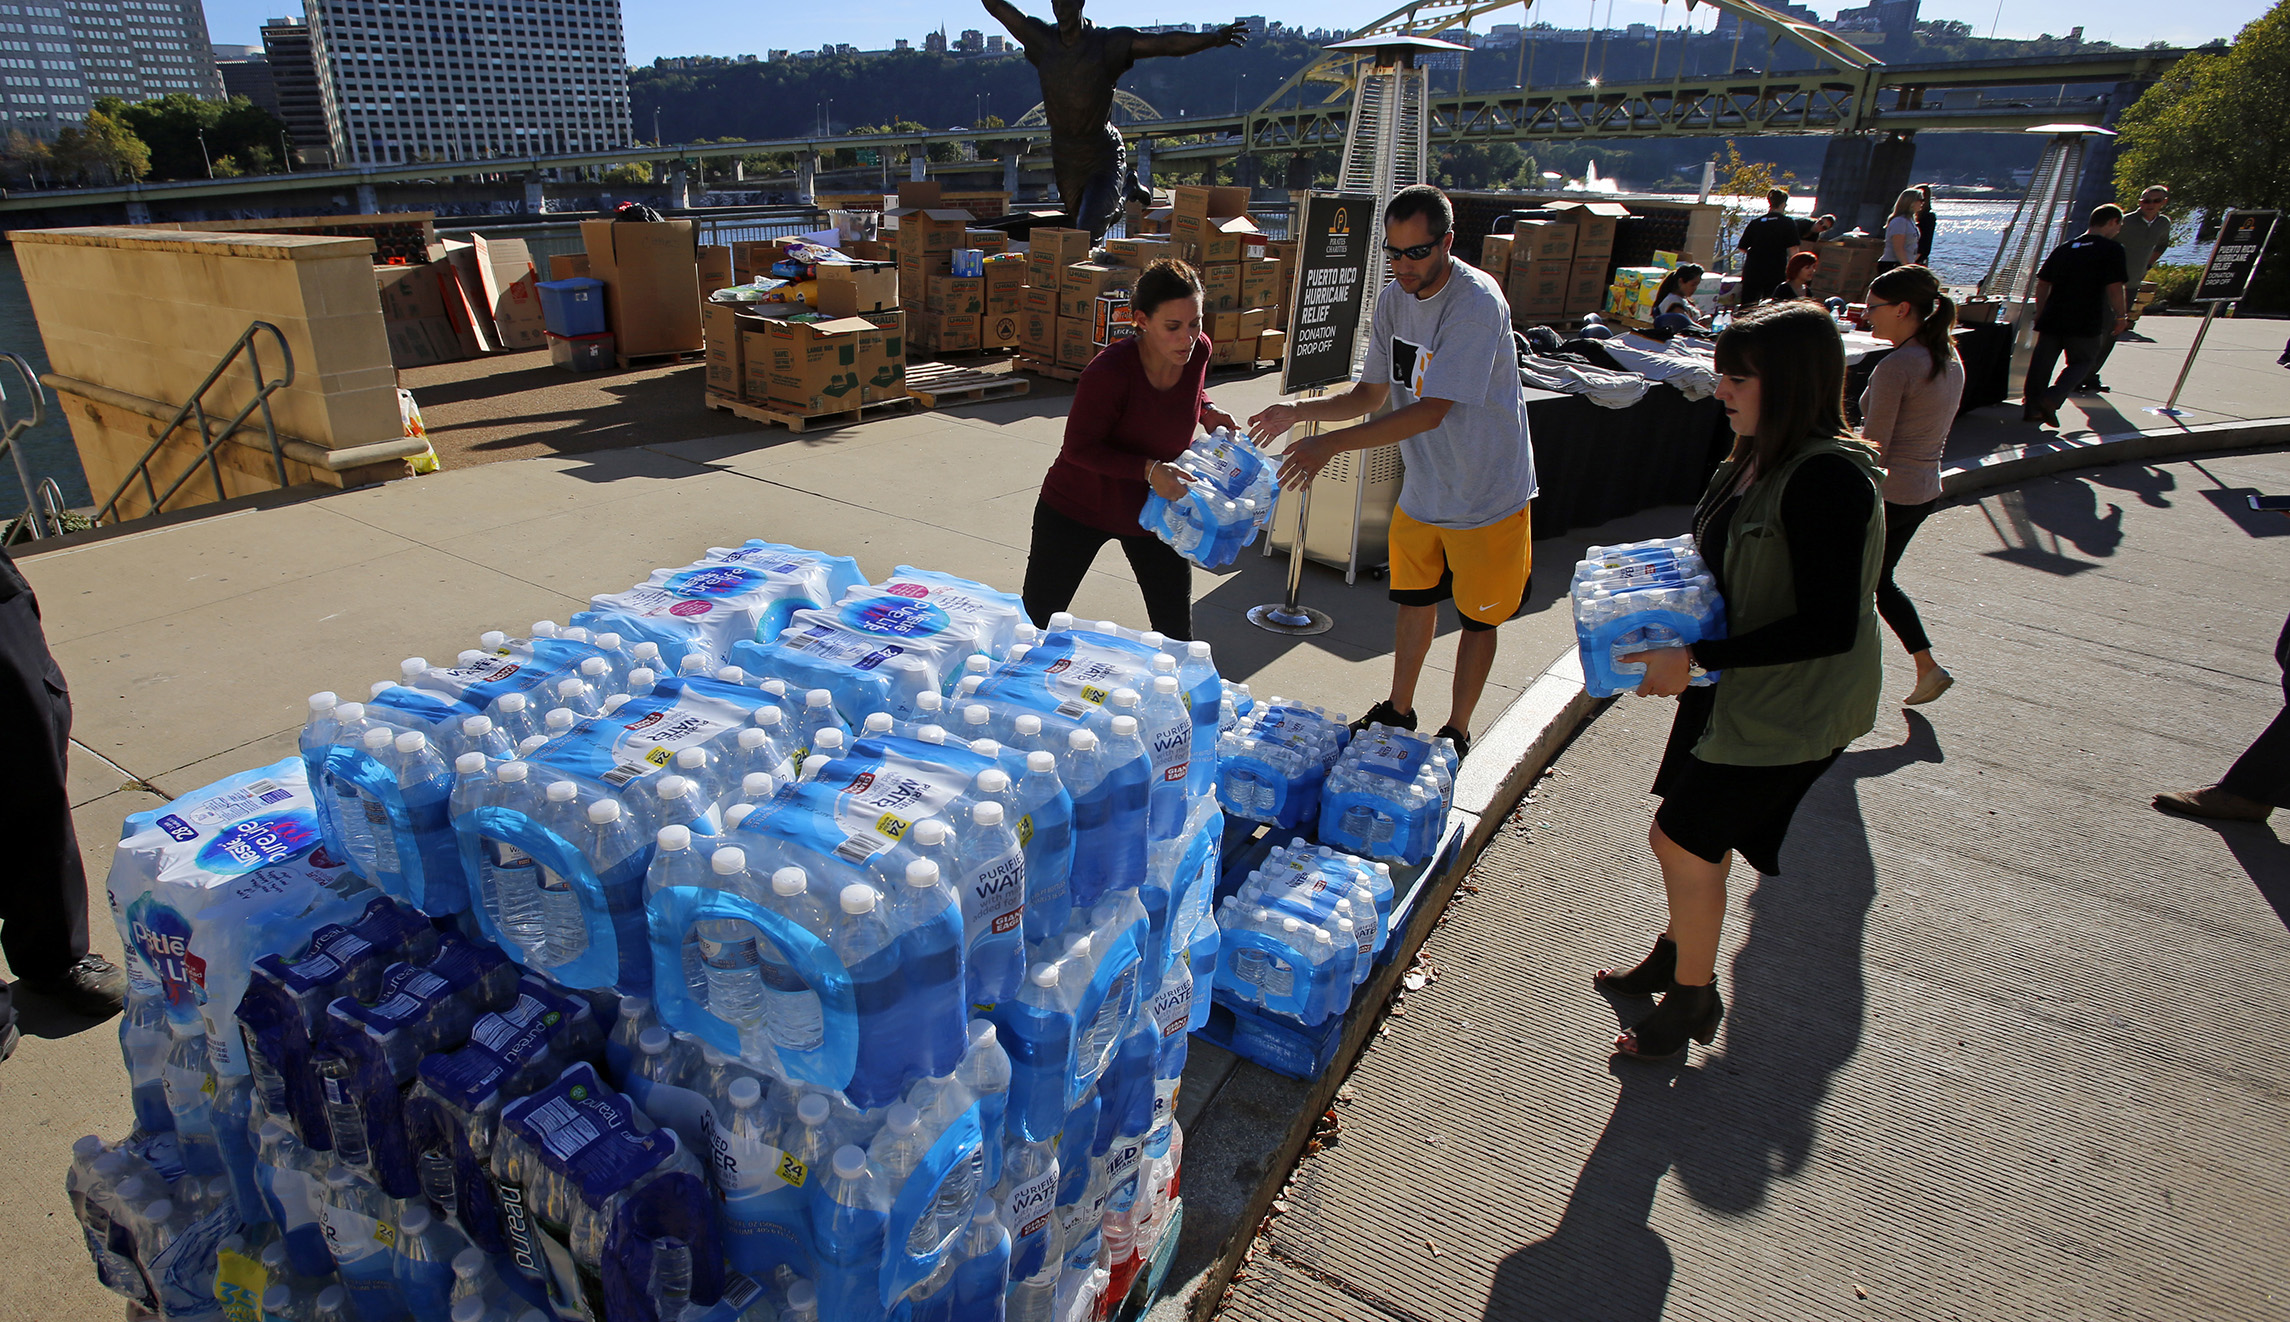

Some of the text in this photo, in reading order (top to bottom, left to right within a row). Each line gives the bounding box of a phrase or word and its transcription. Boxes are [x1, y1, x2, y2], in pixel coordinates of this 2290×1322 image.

[1178, 216, 1199, 226] U-HAUL
[975, 235, 1001, 243] U-HAUL
[1329, 237, 1346, 245] PIRATES
[2215, 253, 2249, 262] HURRICANE
[2218, 245, 2256, 253] PUERTO RICO
[1069, 269, 1090, 279] U-HAUL
[2211, 262, 2232, 271] RELIEF
[1307, 267, 1357, 286] PUERTO RICO
[1304, 286, 1350, 305] HURRICANE
[1301, 305, 1330, 324] RELIEF
[1299, 326, 1336, 342] DONATION
[807, 346, 823, 354] LARGE
[1296, 340, 1333, 357] DROP OFF
[1090, 690, 1105, 703] 24
[1156, 717, 1192, 740] PURIFIE
[1154, 725, 1192, 753] WAT
[653, 751, 671, 765] 24
[1167, 764, 1188, 775] GIAN
[869, 778, 919, 809] WATER
[892, 782, 931, 811] PURIFIED
[886, 819, 907, 837] 24
[976, 862, 1026, 899] WATE
[1154, 979, 1190, 1004] PURIFIED
[1154, 986, 1193, 1015] WATE
[503, 1020, 547, 1065] pureau
[578, 1096, 625, 1129] pureau
[784, 1156, 803, 1177] 24
[1015, 1170, 1058, 1201] PURIFIED
[1012, 1179, 1058, 1214] WATE
[379, 1223, 395, 1239] 24
[499, 1184, 541, 1273] pureau
[219, 1281, 259, 1310] 35
